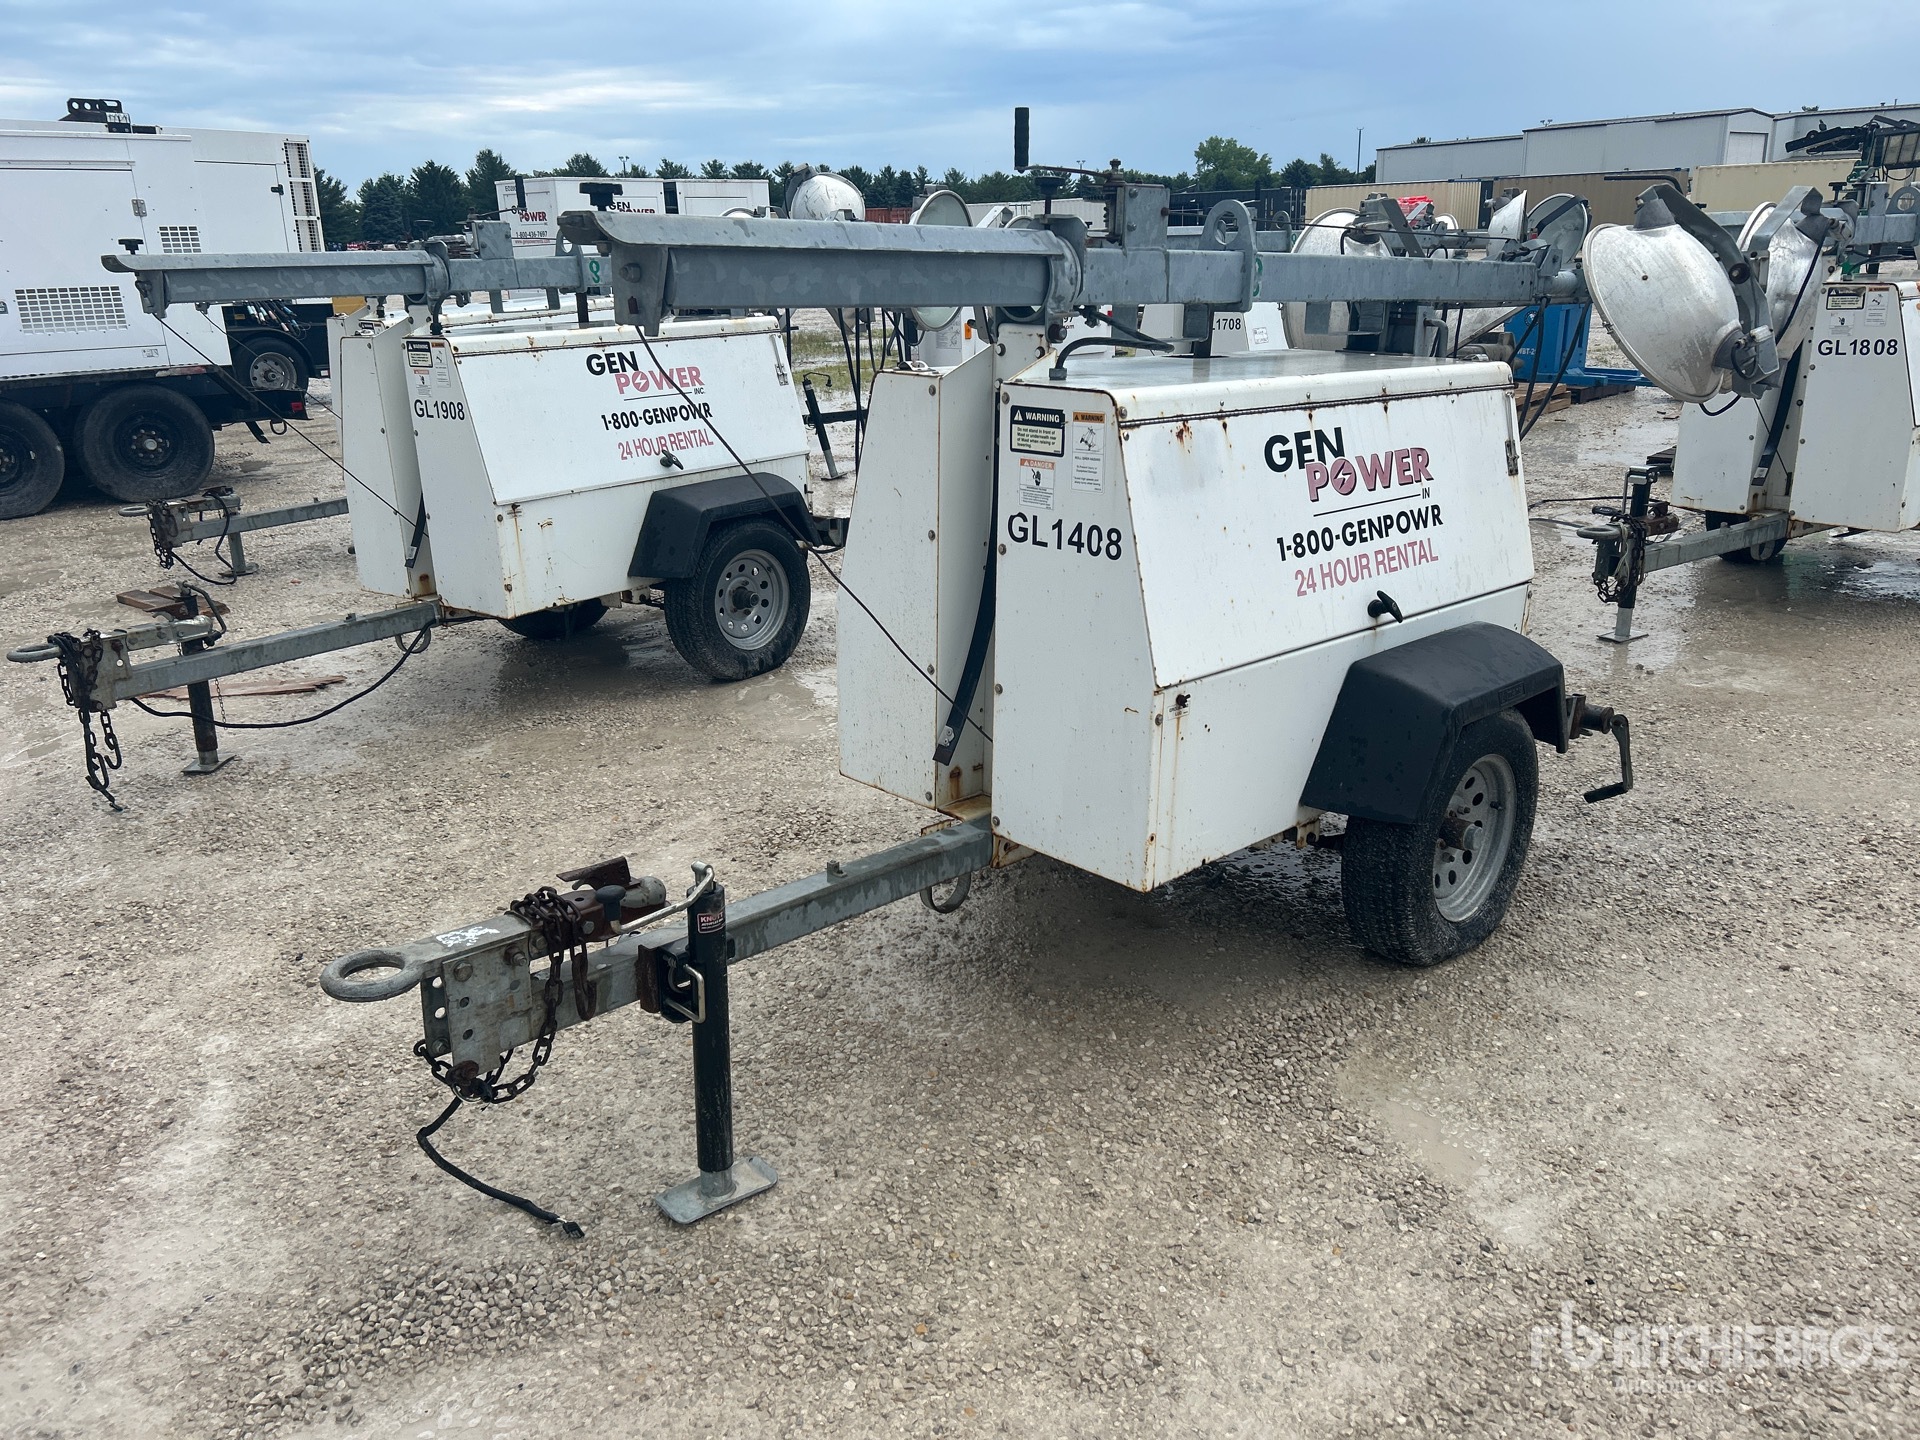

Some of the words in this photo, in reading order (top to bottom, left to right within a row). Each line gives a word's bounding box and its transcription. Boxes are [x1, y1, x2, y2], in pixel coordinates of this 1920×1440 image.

[520, 211, 547, 222] POWER
[1212, 318, 1242, 331] 1708
[1817, 339, 1898, 356] GL1808
[586, 351, 639, 375] GEN
[614, 366, 705, 395] POWER
[414, 399, 465, 420] GL1908
[601, 402, 713, 430] 1-800-GENPOWR
[1025, 411, 1060, 423] WARNING
[618, 440, 633, 460] 24
[633, 435, 668, 457] HOUR
[668, 429, 714, 451] RENTAL
[1264, 427, 1345, 473] GEN
[1030, 460, 1053, 469] DANGER
[1305, 447, 1434, 502] POWER
[1007, 511, 1122, 560] GL1408
[1276, 504, 1444, 561] 1-800-GENPOWR
[1294, 567, 1317, 597] 24
[1319, 553, 1372, 590] HOUR
[1374, 537, 1439, 576] RENTAL
